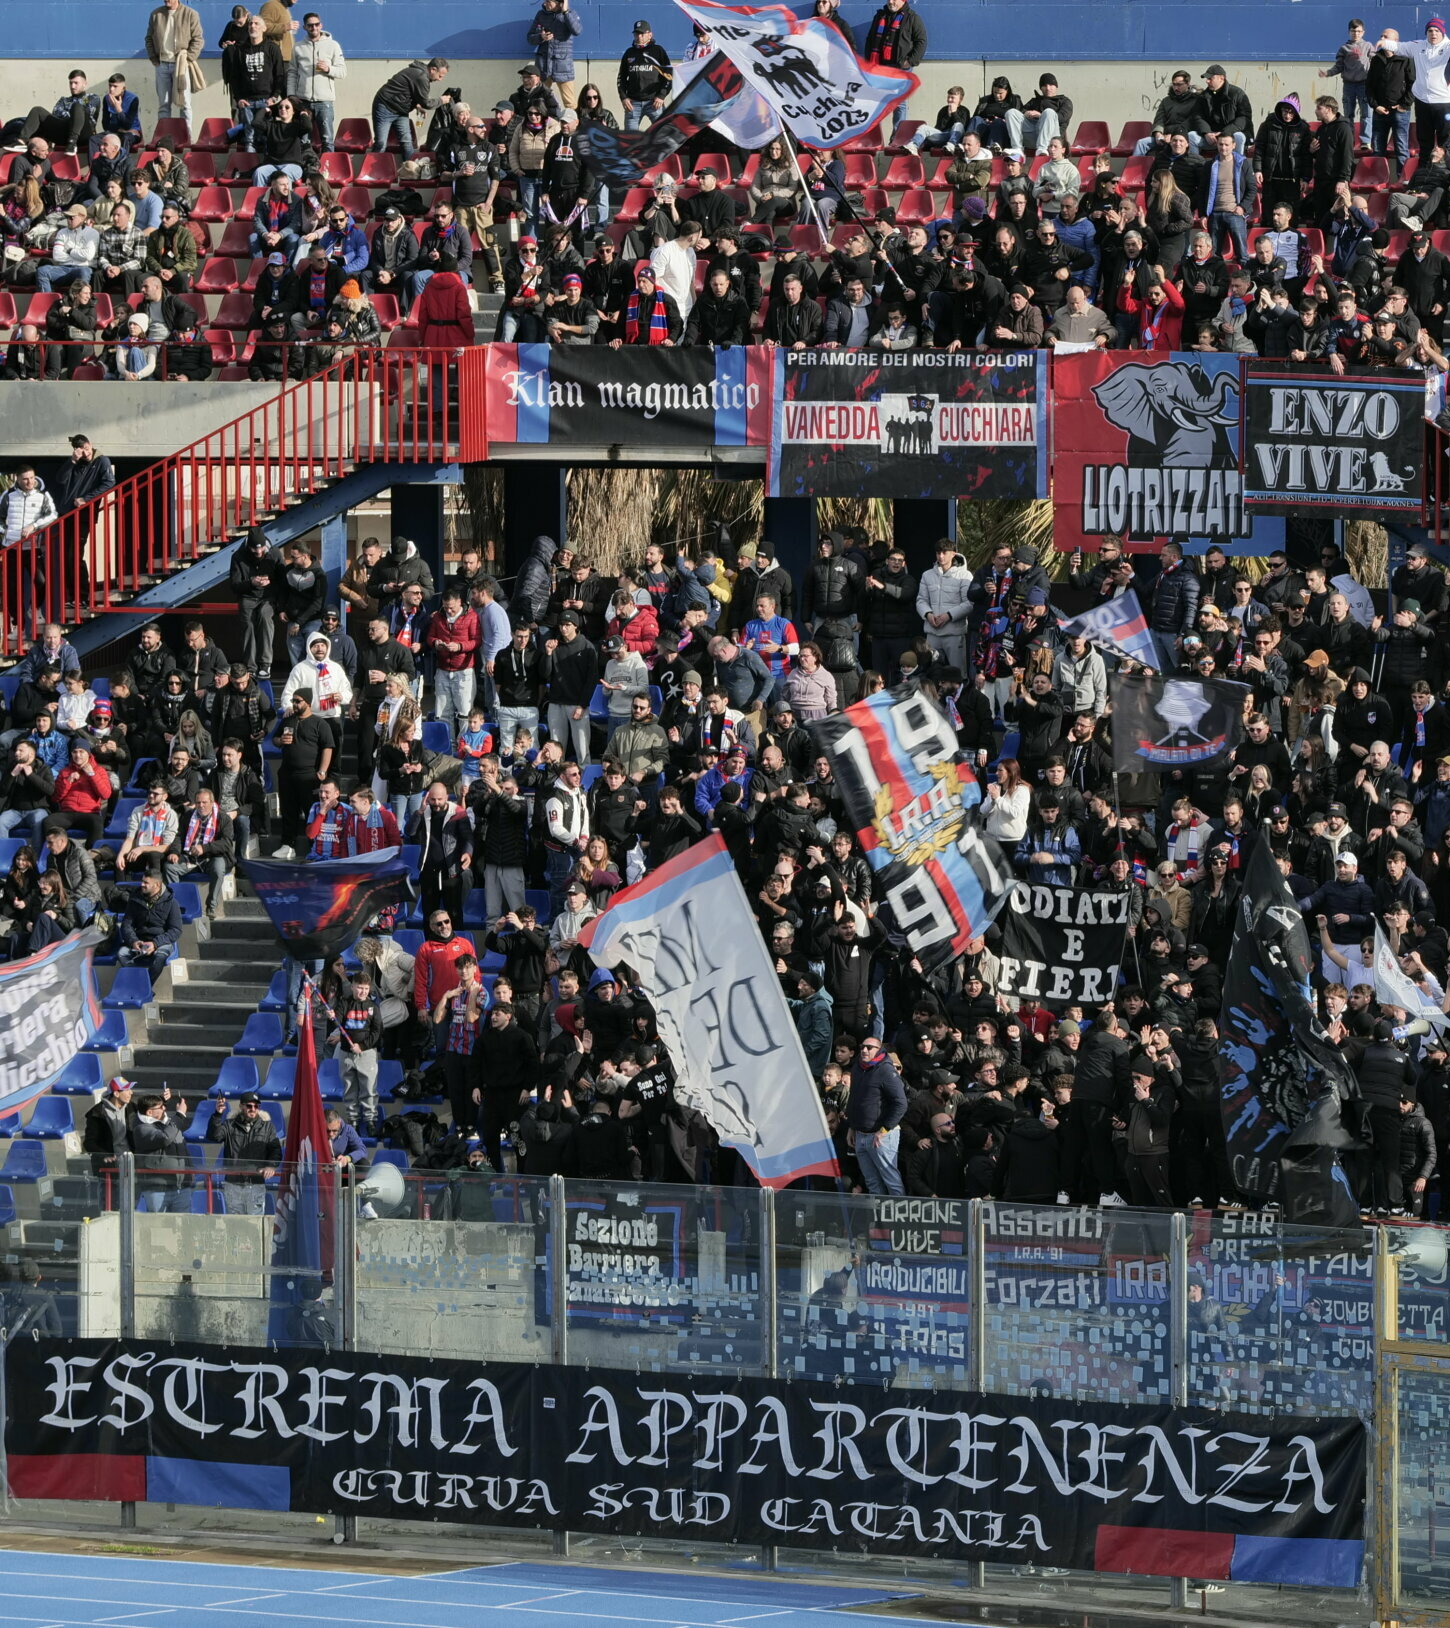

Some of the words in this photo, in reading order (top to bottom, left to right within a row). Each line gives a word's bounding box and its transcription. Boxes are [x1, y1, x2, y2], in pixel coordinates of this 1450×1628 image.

[816, 109, 870, 141] 2023
[787, 352, 817, 367] PER
[819, 352, 877, 367] AMORE
[883, 352, 908, 367] DEI
[912, 353, 971, 368] NOSTRI
[975, 353, 1034, 368] COLORI
[503, 371, 585, 407] Klan
[599, 373, 760, 419] magmatico
[1268, 387, 1401, 438] ENZO
[785, 404, 880, 441] VANEDDA
[939, 405, 1035, 442] CUCCHIARA
[1254, 443, 1367, 493] VIVE
[880, 776, 962, 850] I.R.A.
[1062, 928, 1085, 961] E
[576, 1211, 658, 1247] Sezione
[873, 1200, 962, 1225] TORRONE
[982, 1204, 1103, 1239] Assenti
[1222, 1211, 1275, 1236] SAR
[567, 1243, 661, 1276] Barriera
[983, 1269, 1101, 1306] Forzati
[39, 1351, 518, 1459] ESTREMA
[564, 1385, 1339, 1517] APPARTENENZA
[333, 1467, 563, 1516] CURVA
[583, 1482, 732, 1527] SUD
[762, 1496, 1053, 1552] CATANIA
